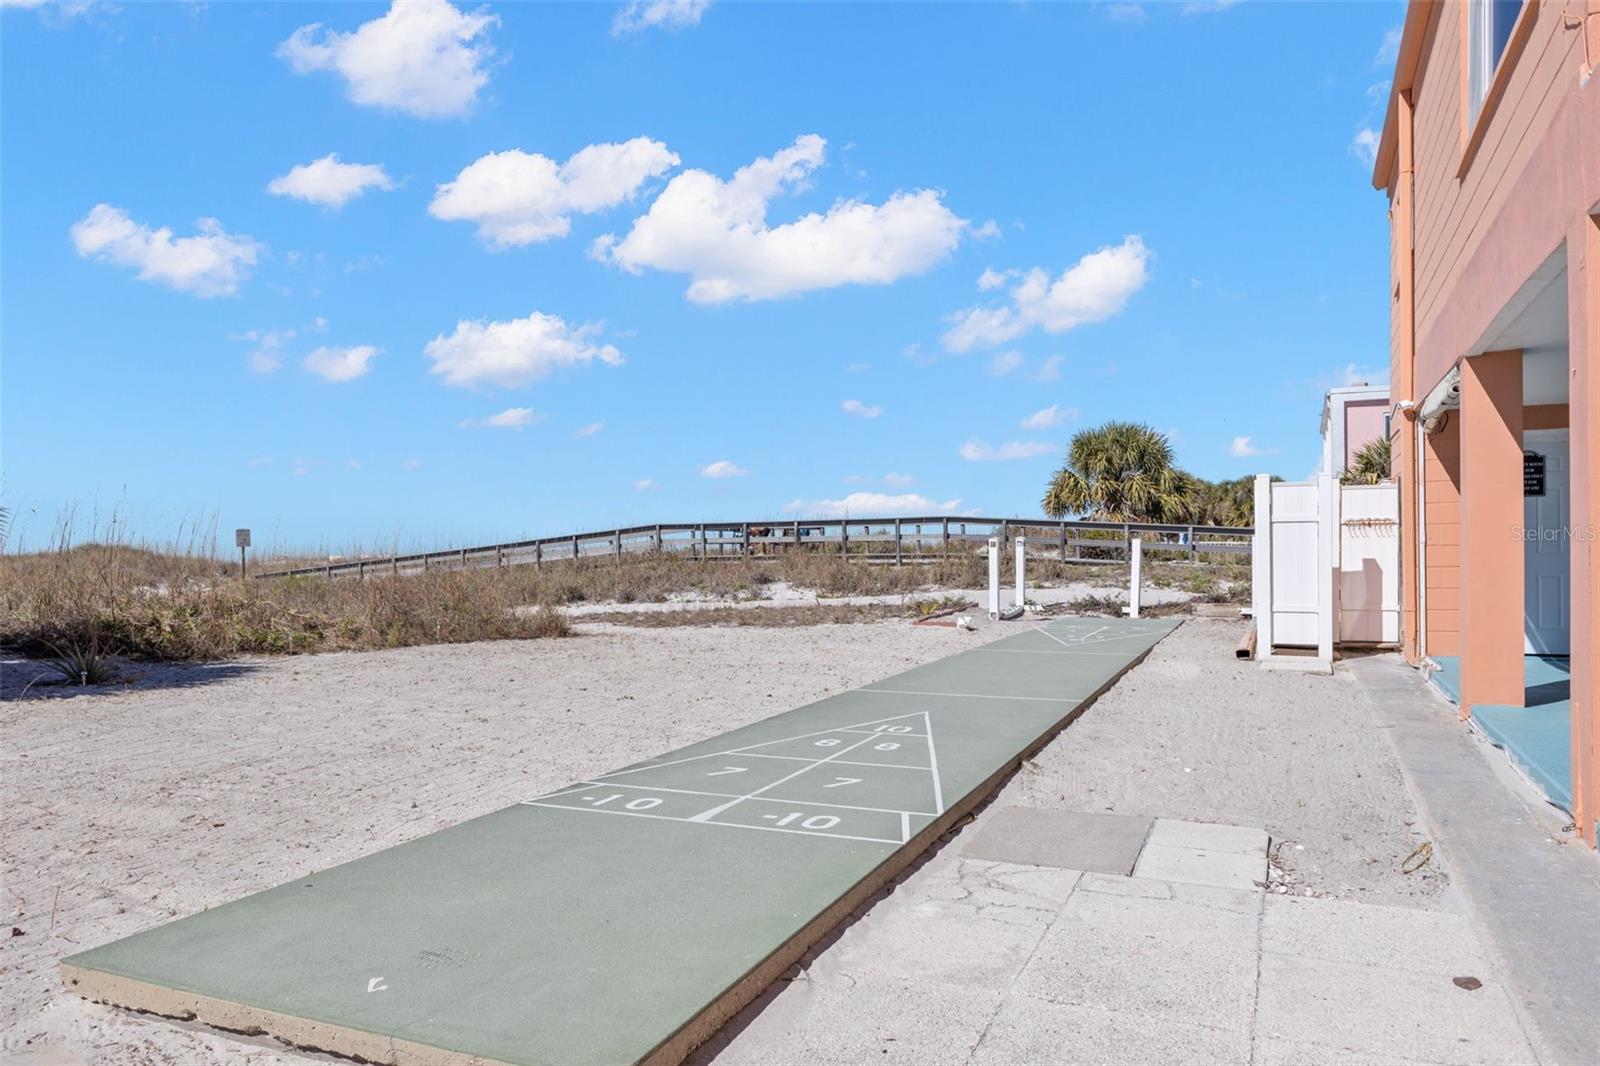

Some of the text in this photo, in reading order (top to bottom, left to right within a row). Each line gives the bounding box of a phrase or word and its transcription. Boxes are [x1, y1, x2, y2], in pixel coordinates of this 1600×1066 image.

[874, 725, 913, 733] 10
[814, 738, 841, 747] 8
[873, 742, 901, 751] 8
[705, 766, 749, 776] 7
[823, 777, 863, 788] 7
[763, 812, 841, 830] -10
